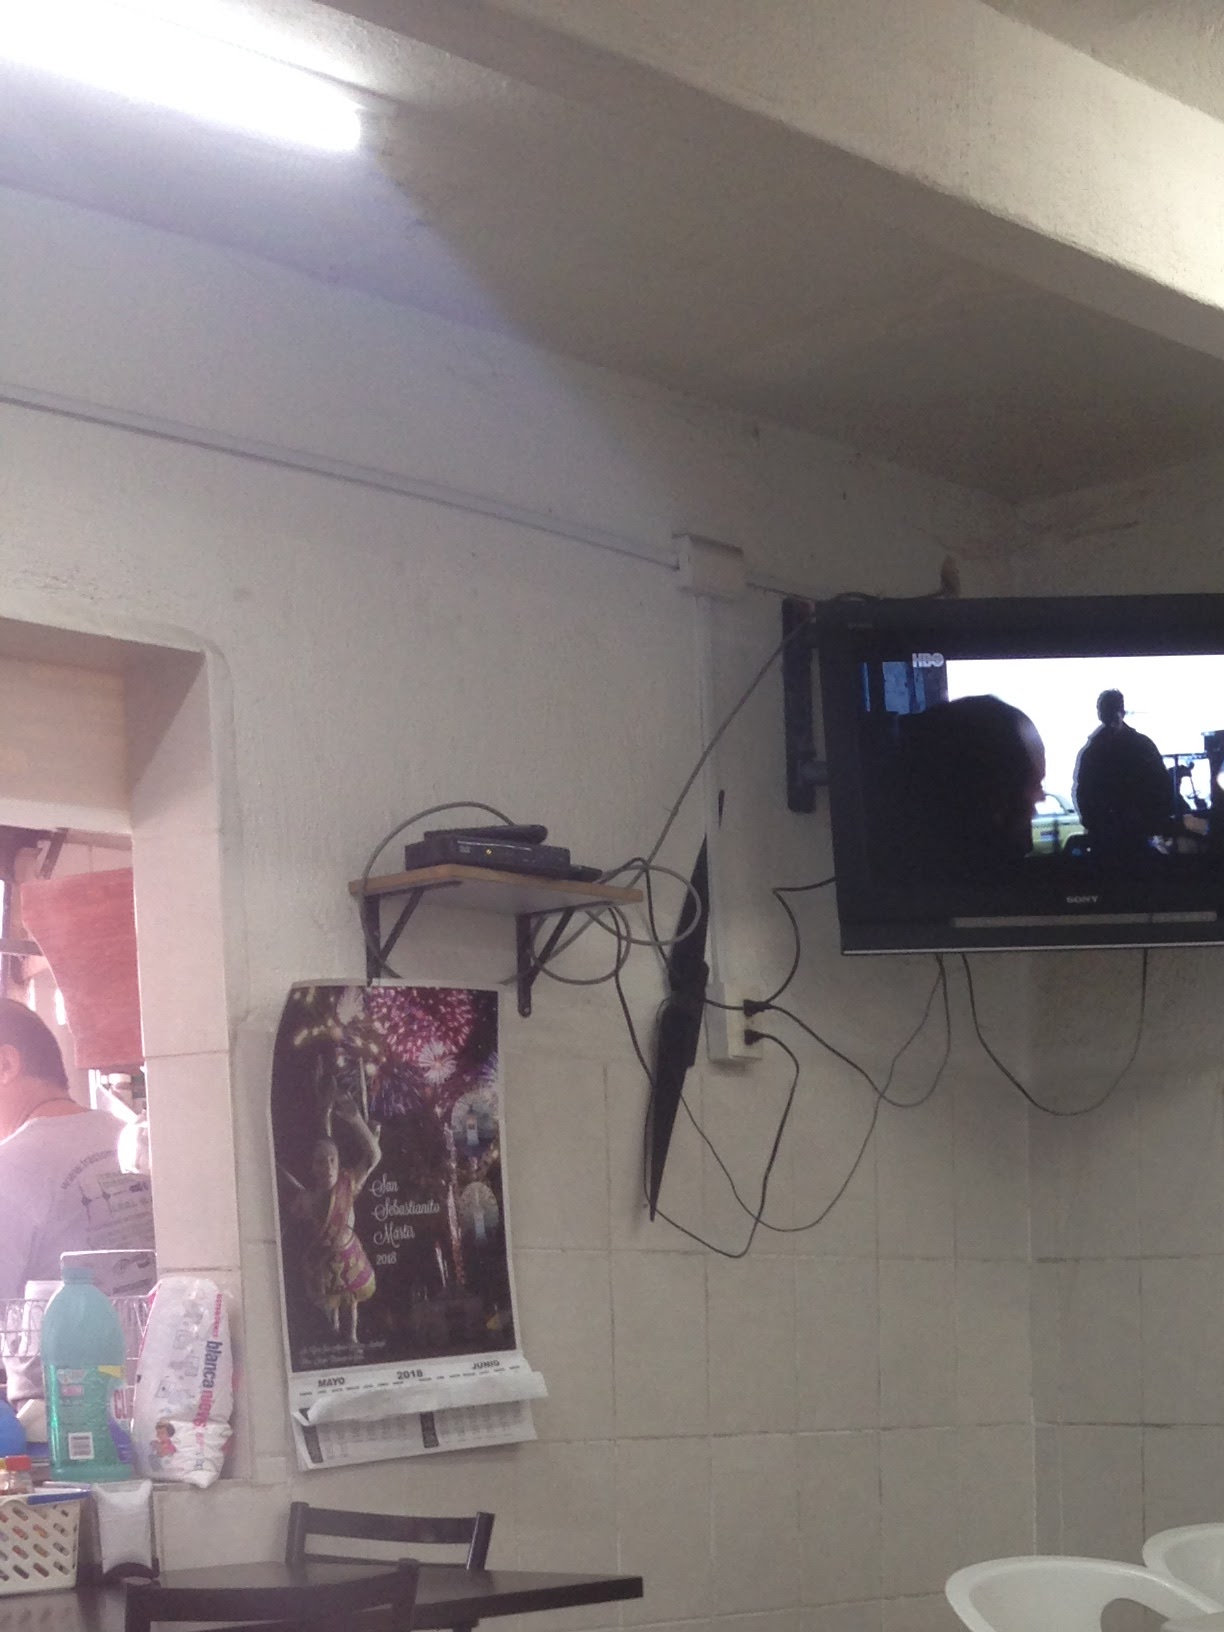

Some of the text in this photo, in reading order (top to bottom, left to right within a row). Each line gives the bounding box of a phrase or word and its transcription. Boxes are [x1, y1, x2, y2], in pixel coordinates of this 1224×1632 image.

[912, 653, 944, 668] HBO
[1066, 896, 1098, 904] SONY
[202, 1340, 223, 1389] blanca
[318, 1377, 345, 1388] MAYO
[397, 1369, 423, 1380] 2018
[472, 1360, 500, 1370] JUNIO
